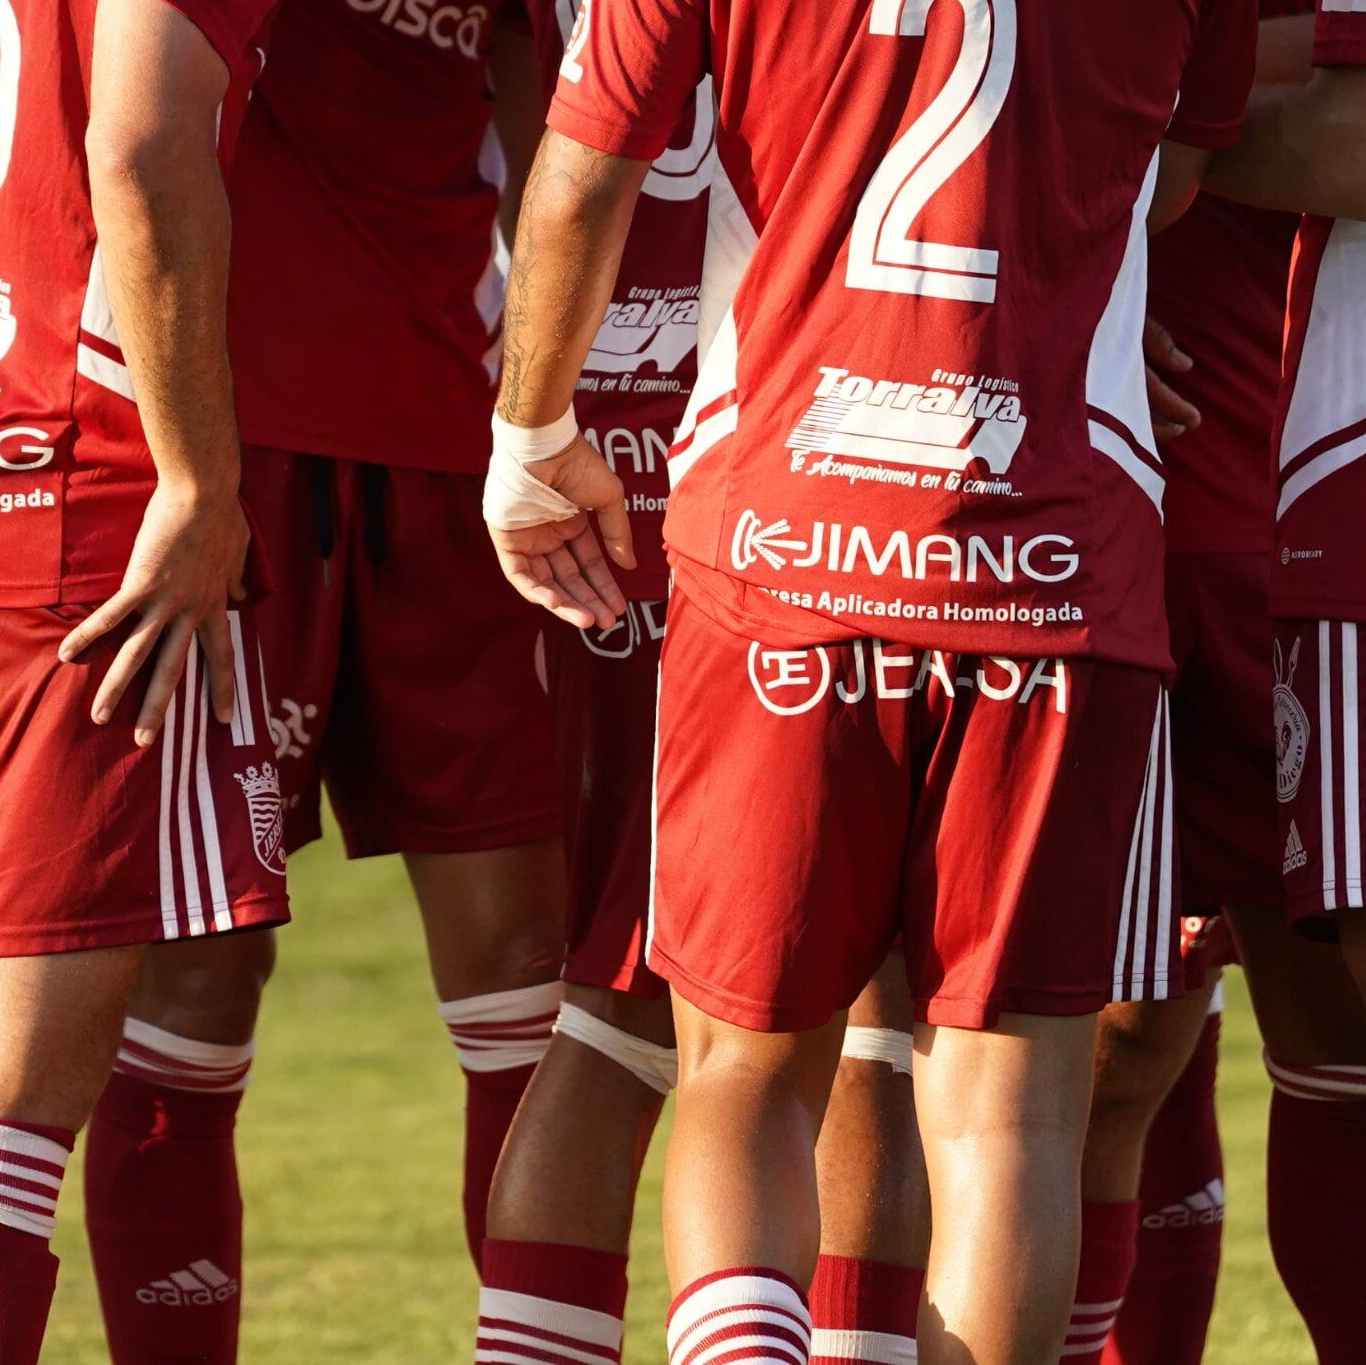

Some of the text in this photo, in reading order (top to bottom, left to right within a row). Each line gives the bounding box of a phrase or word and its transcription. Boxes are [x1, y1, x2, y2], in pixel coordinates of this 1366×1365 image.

[628, 286, 662, 300] Grupo
[601, 378, 617, 391] en
[633, 376, 691, 393] camino...
[813, 366, 1022, 422] Torralva
[931, 368, 974, 386] Grupo
[791, 450, 811, 473] Te
[920, 473, 942, 489] en
[962, 478, 1023, 497] camino...
[793, 521, 1079, 583] JIMANG
[817, 591, 938, 616] Aplicadora
[943, 602, 1083, 627] Homologada
